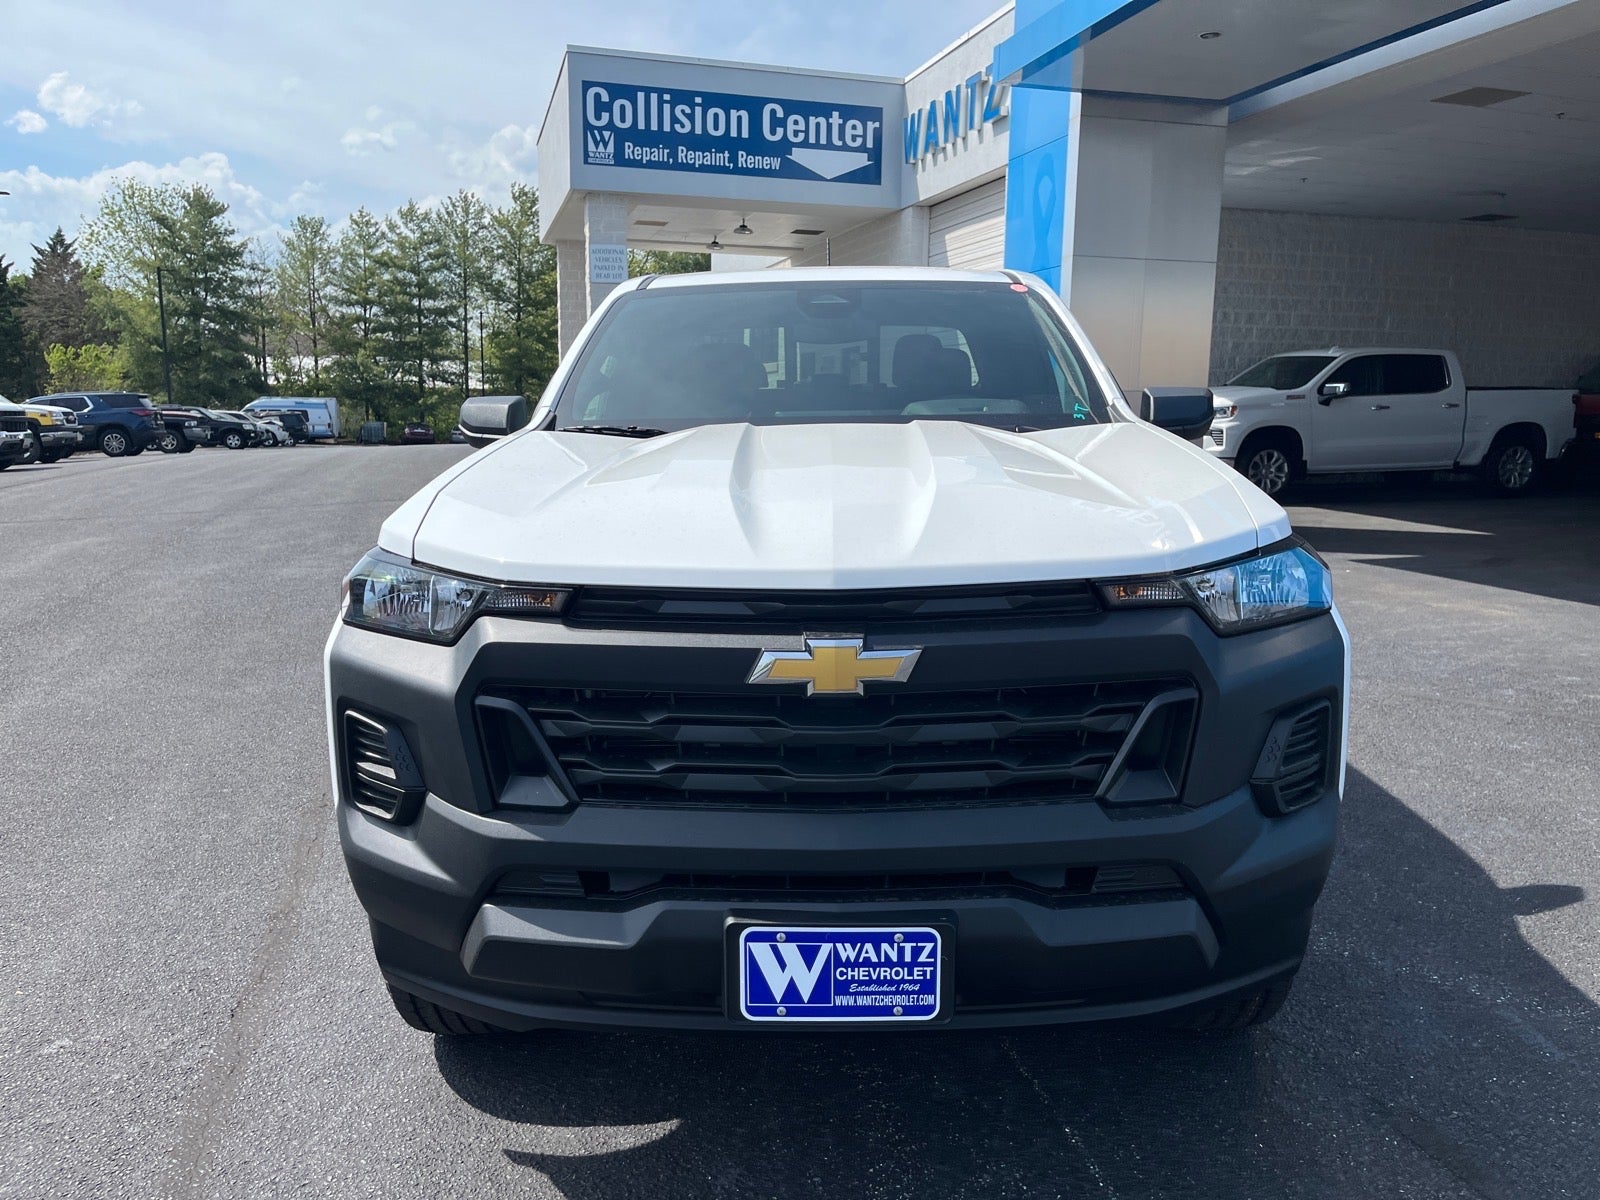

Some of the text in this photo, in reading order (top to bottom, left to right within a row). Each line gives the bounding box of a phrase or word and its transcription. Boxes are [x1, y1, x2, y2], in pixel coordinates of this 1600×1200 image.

[586, 86, 880, 148] Collision Center
[903, 63, 1004, 164] WANTZ
[588, 151, 614, 159] WANTZ
[624, 141, 781, 170] Repair, Repaint, Renew
[835, 942, 935, 963] WANTZ
[748, 943, 833, 1004] W
[835, 967, 934, 980] CHEVROLET
[849, 983, 920, 992] Established 1964
[834, 994, 935, 1006] WWW.WANTZCHEVROLET.COM
